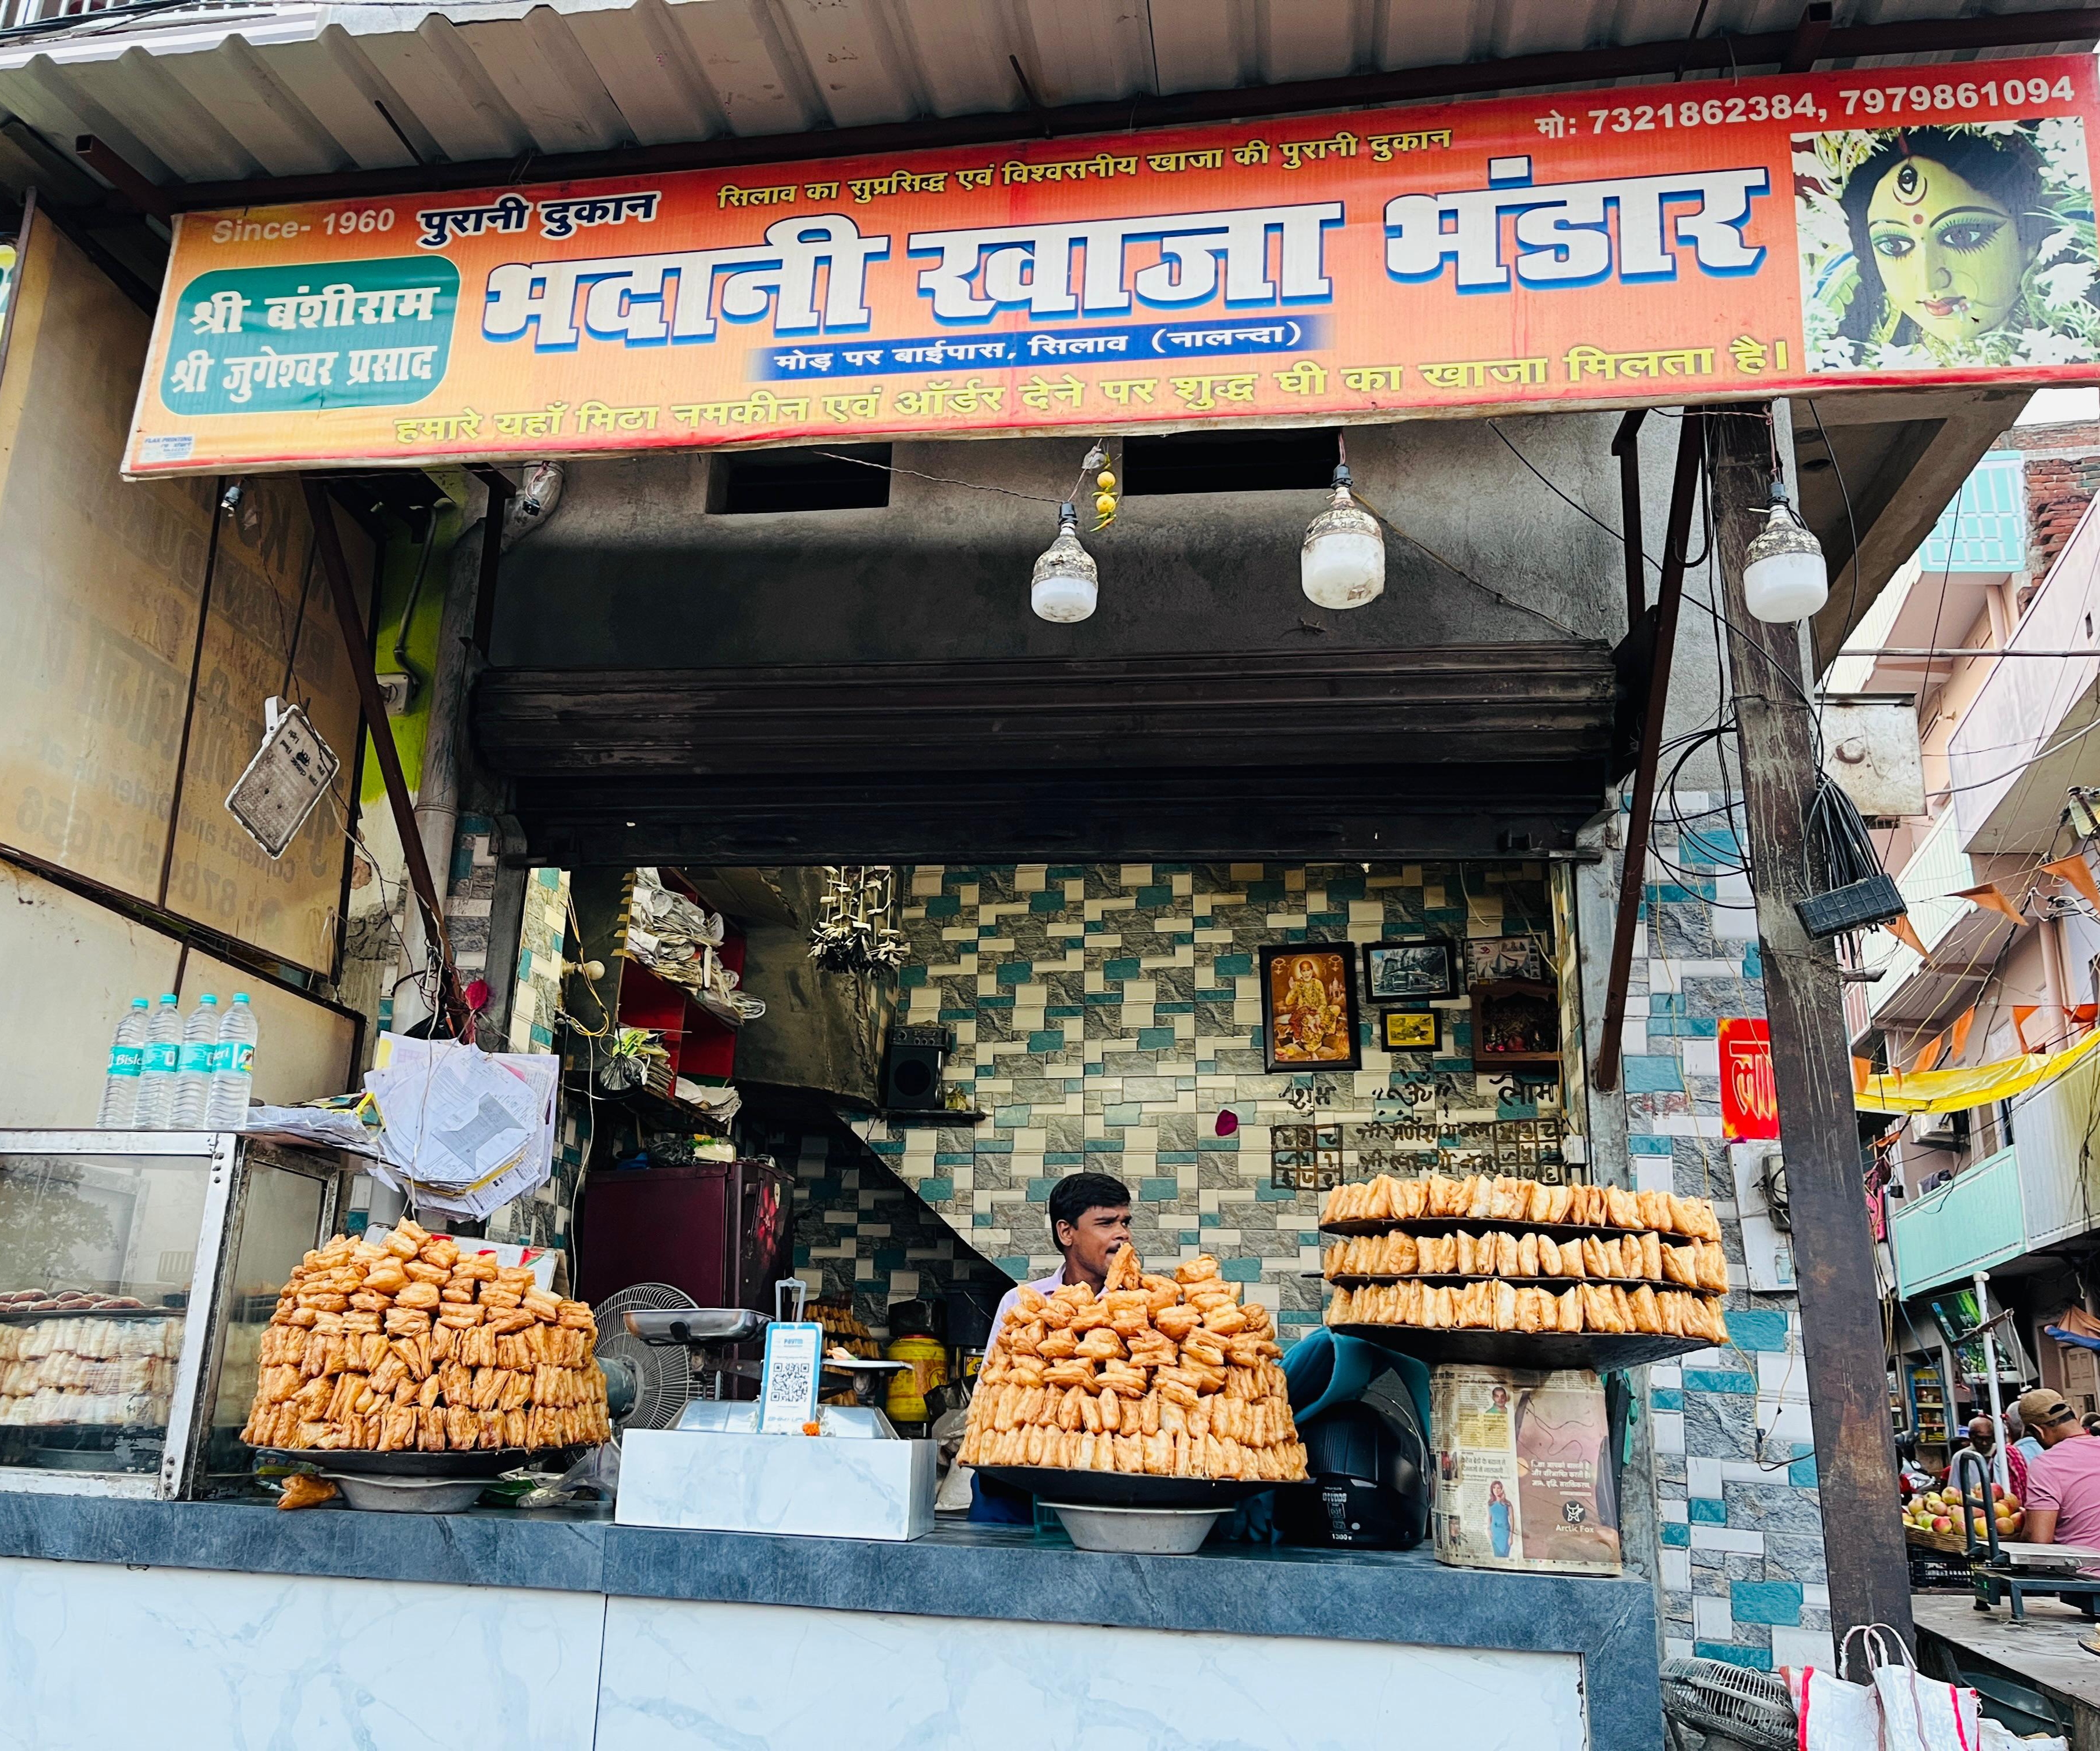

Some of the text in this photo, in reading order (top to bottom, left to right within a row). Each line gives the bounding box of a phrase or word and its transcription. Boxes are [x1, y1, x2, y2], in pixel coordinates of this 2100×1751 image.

[1588, 91, 1827, 135] 7321862384,
[1839, 75, 2076, 115] 7979861094
[717, 128, 1453, 208] सिलाव का सुप्रसिद्ध एवं विश्वसनीय खाजा की पुरानी दुकान
[212, 208, 395, 244] Since- 1960
[417, 192, 659, 248] पुरानी दुकान
[482, 154, 1770, 354] भदानी खाजा भंडार
[189, 283, 441, 335] श्री बंशीराम
[170, 345, 438, 402] श्री जुगेश्वर प्रसाद
[774, 321, 1302, 372] मोड़ पर बाईपास, सिलाव (नालन्दा)
[394, 408, 483, 444] हमारे
[496, 400, 570, 438] यहाँ
[671, 390, 811, 427] नमकीन
[822, 387, 884, 423] एवं
[895, 377, 1005, 416] ऑर्डर
[1016, 372, 1085, 412] देने
[1100, 376, 1159, 406] पर
[1170, 371, 1258, 411] शुद्ध
[1274, 360, 1328, 396] घी
[1340, 364, 1403, 392] का
[1419, 356, 1548, 389] खाजा
[1563, 344, 1716, 384] मिलता
[1556, 1524, 1577, 1533] Arctic
